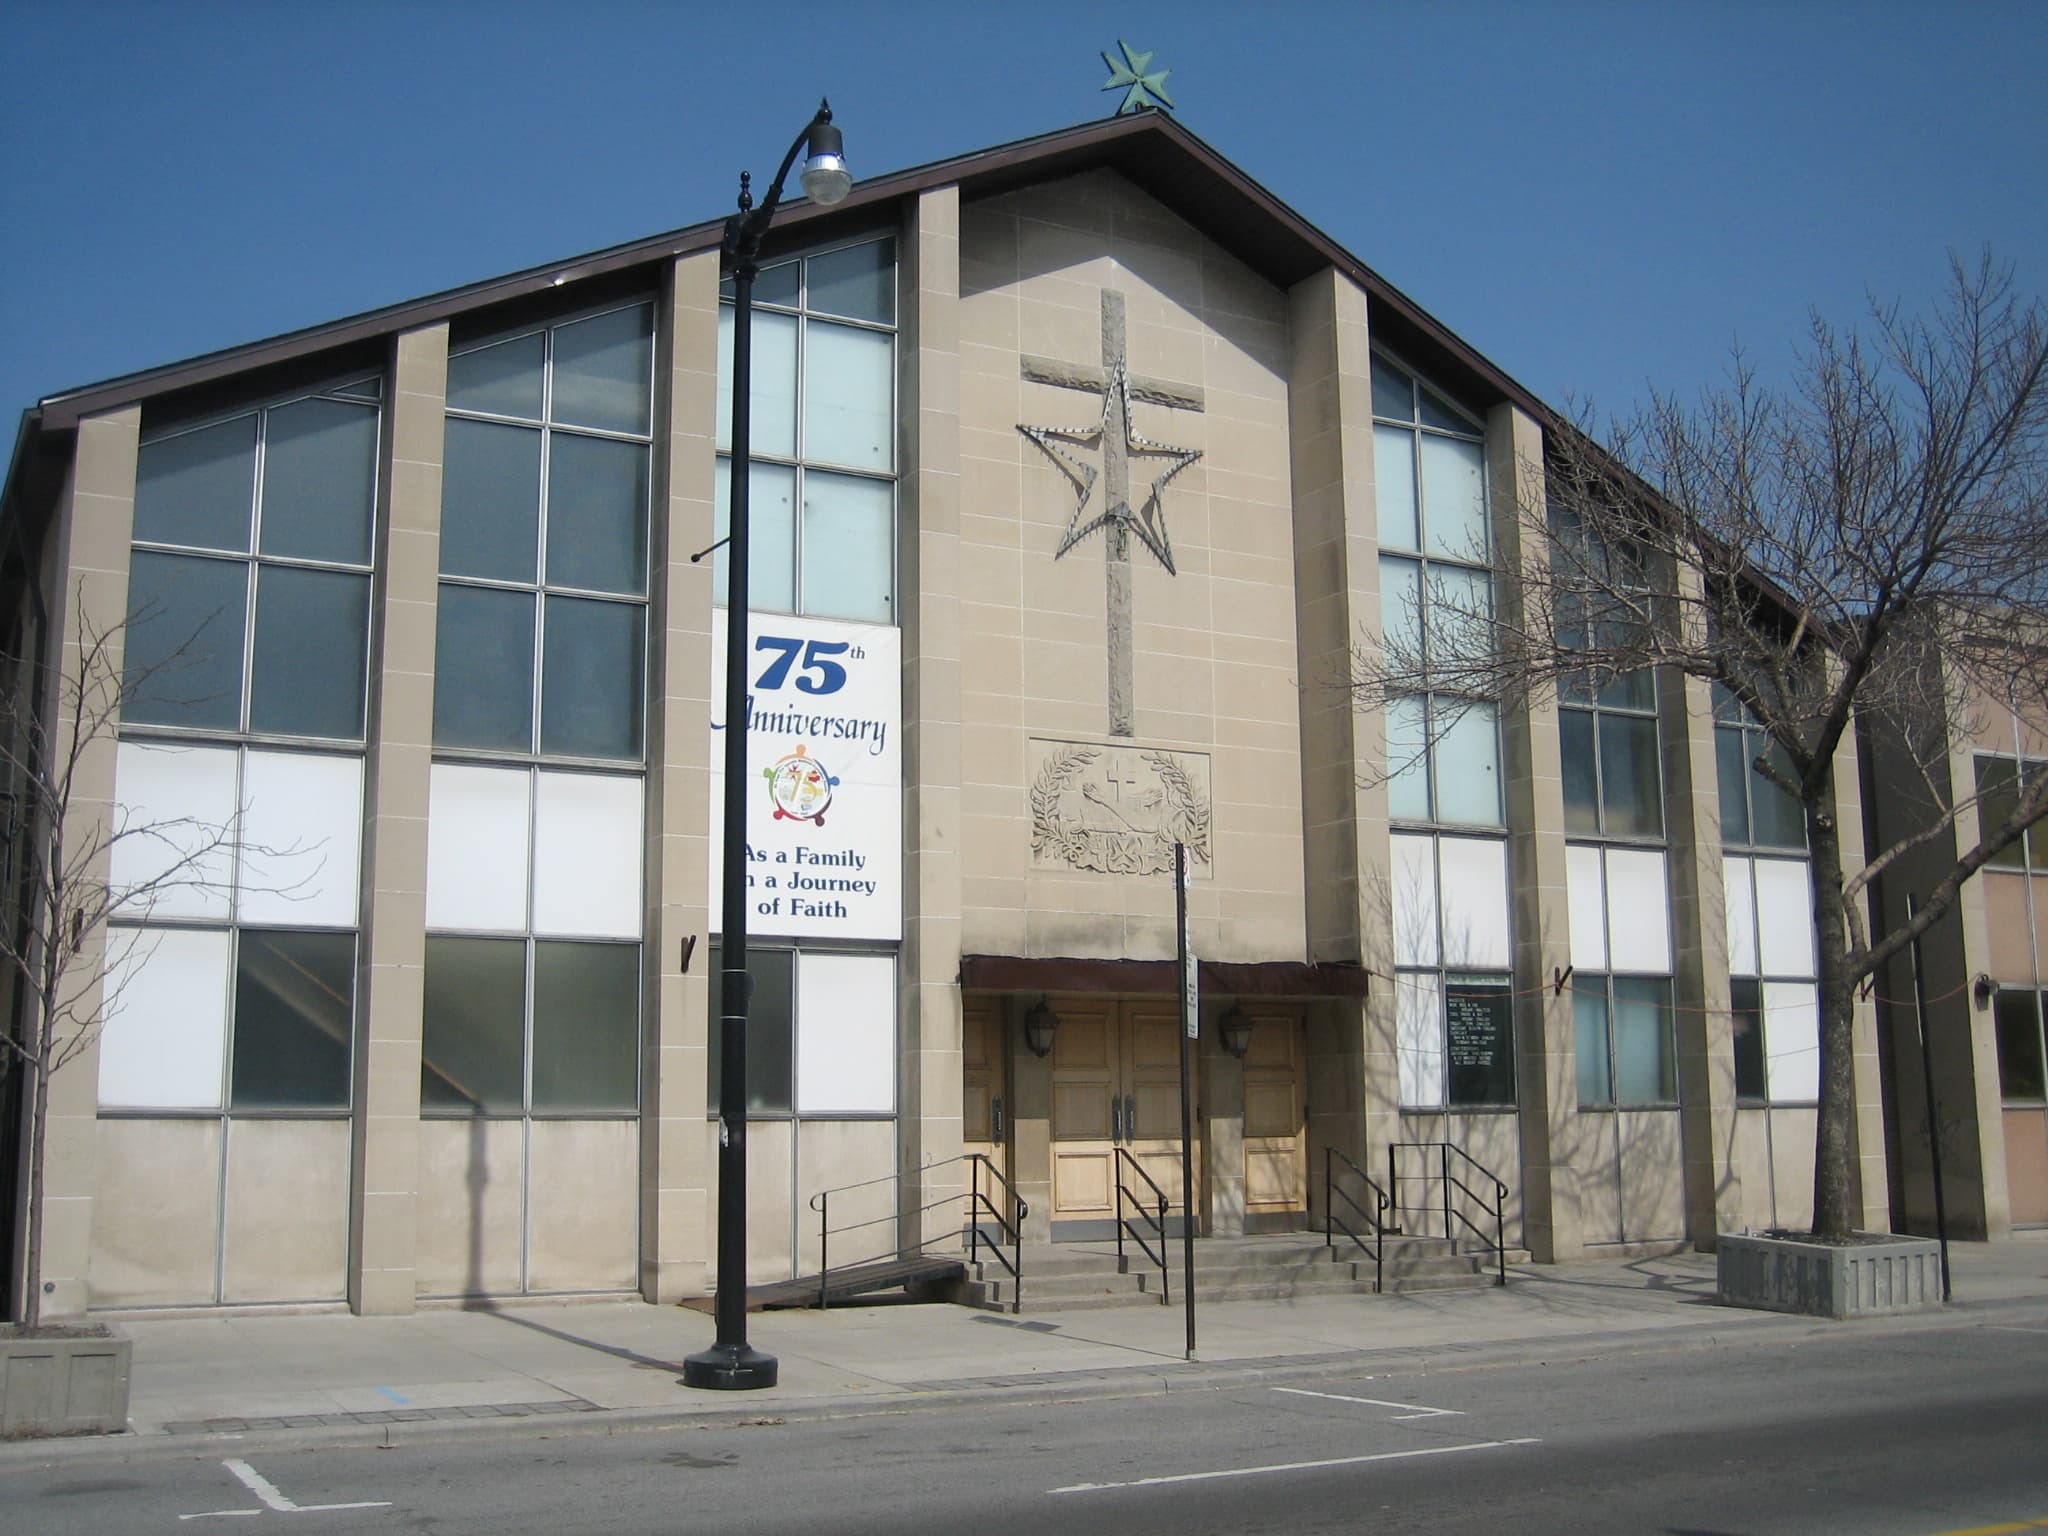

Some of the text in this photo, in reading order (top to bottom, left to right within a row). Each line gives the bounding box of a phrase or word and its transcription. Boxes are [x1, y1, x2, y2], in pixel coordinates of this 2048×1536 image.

[746, 844, 865, 871] As a Family
[765, 876, 777, 888] a
[788, 869, 876, 896] Journey
[758, 898, 847, 918] of Faith
